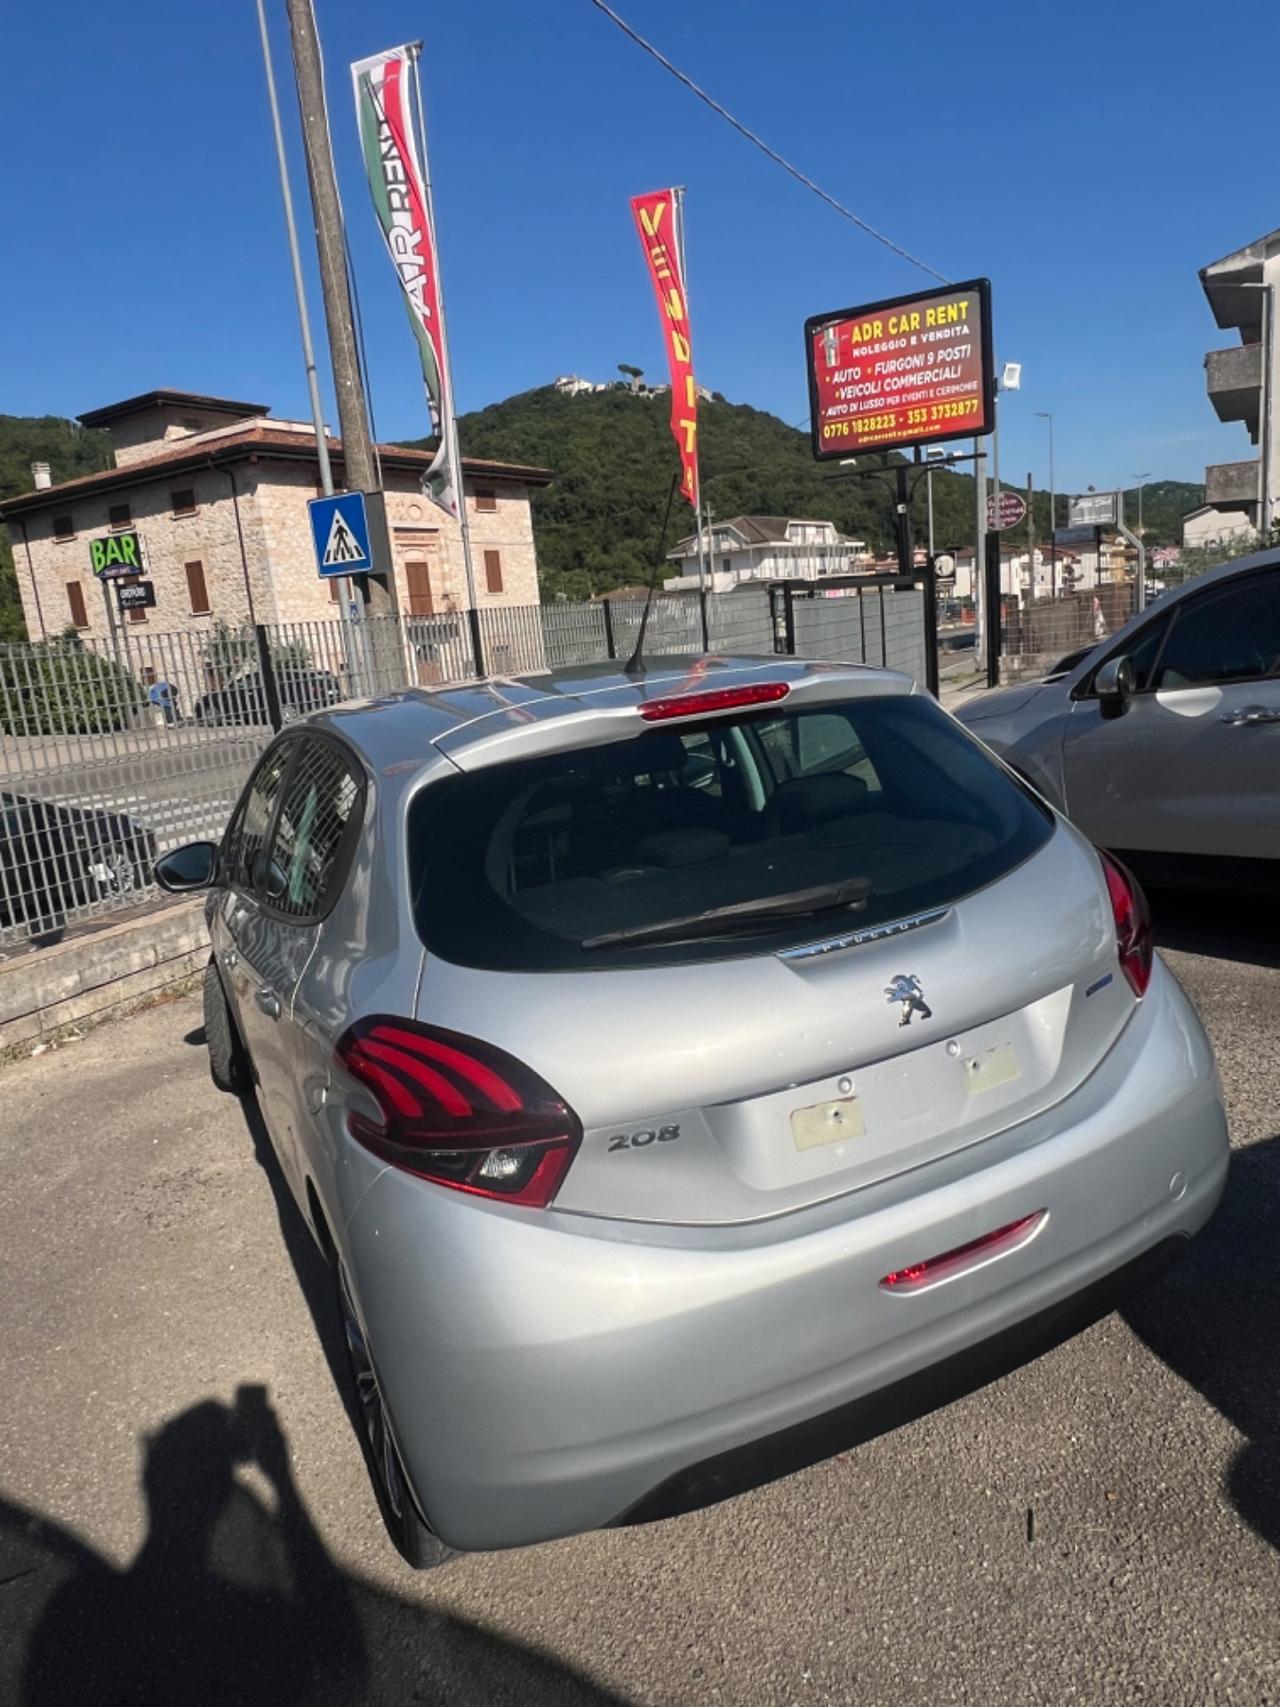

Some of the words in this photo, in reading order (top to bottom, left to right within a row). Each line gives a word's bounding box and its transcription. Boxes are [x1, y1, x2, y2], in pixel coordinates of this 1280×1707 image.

[852, 320, 883, 344] ADR
[888, 312, 920, 335] CAR
[926, 301, 969, 327] RENT
[853, 338, 907, 358] NOLEGGIO
[910, 335, 918, 346] E
[921, 324, 970, 343] VENDITA
[832, 367, 861, 384] AUTO
[874, 354, 925, 376] FURGONI
[927, 352, 935, 365] 9
[937, 344, 972, 363] POSTI
[839, 381, 882, 400] VEICOLI
[883, 365, 962, 391] COMMERCIALI
[826, 404, 848, 417] AUTO
[850, 402, 858, 412] DI
[860, 397, 885, 411] LUSSO
[886, 395, 900, 406] PER
[902, 390, 928, 403] EVENTI
[935, 380, 978, 396] CERIMONIE
[823, 422, 849, 438] 0776
[907, 408, 927, 424] 353
[931, 399, 978, 420] 3732877
[90, 534, 140, 574] BAR
[607, 1124, 681, 1153] 208
